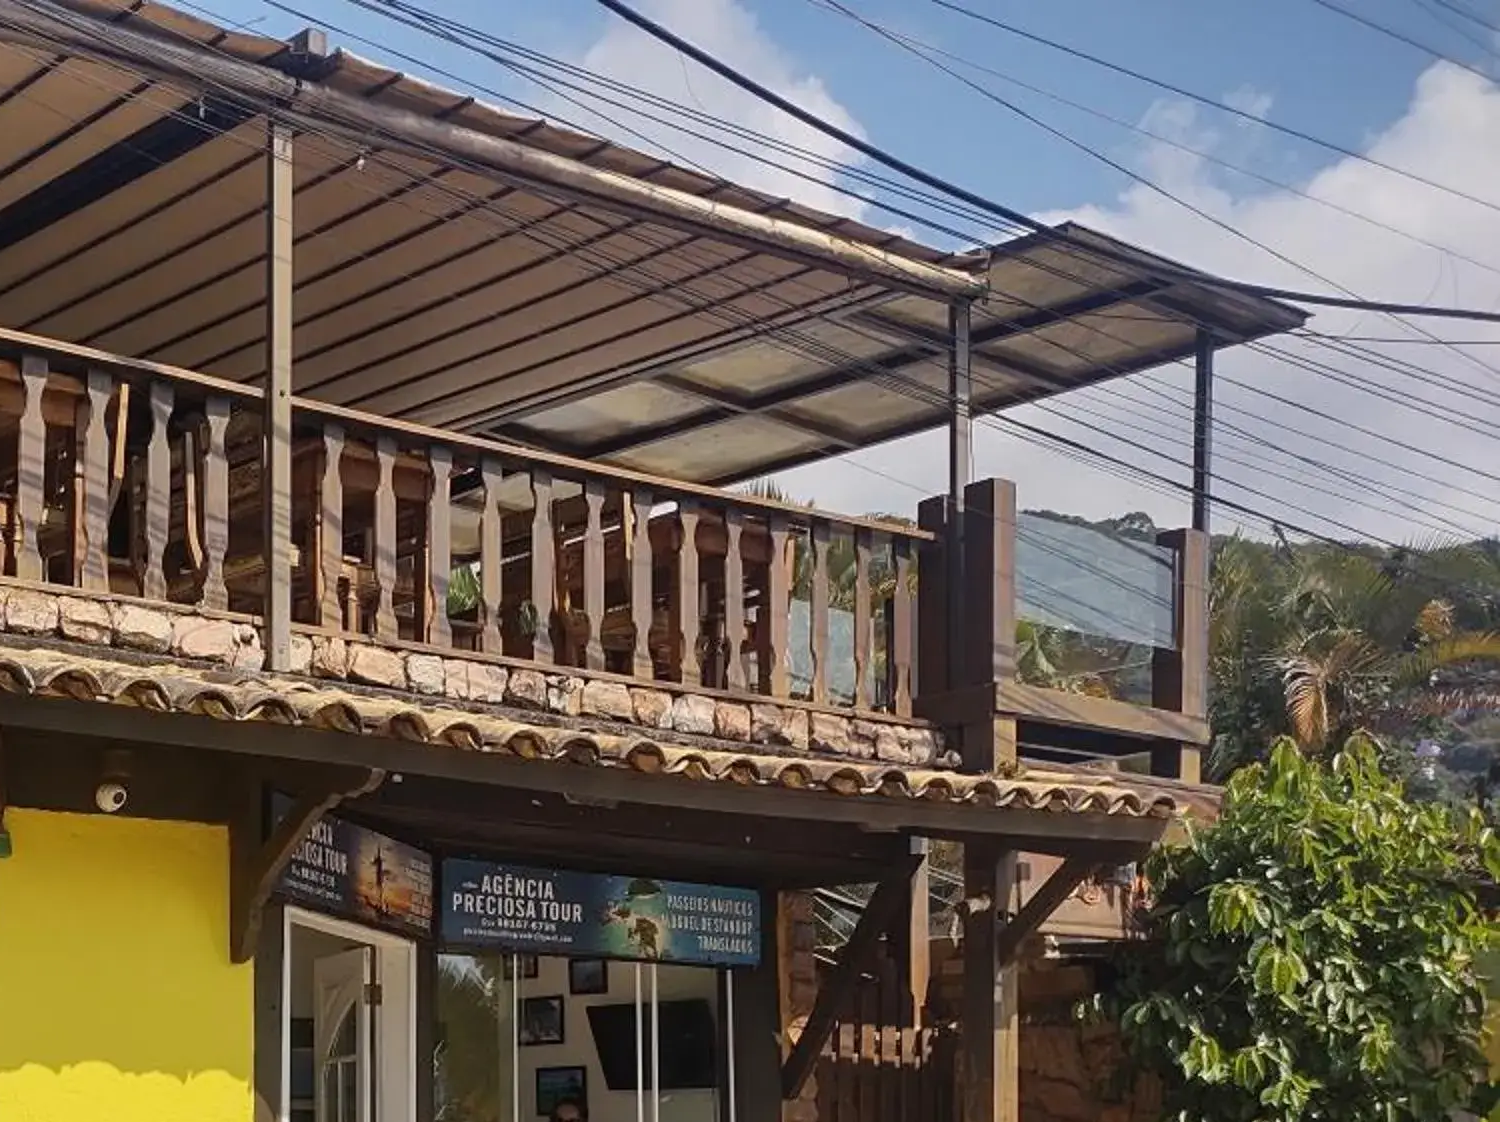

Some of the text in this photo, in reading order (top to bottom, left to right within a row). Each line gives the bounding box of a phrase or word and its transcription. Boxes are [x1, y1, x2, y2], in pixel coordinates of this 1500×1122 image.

[481, 873, 555, 900] AGÊNCIA
[453, 891, 583, 922] PRECIOSA TOUR
